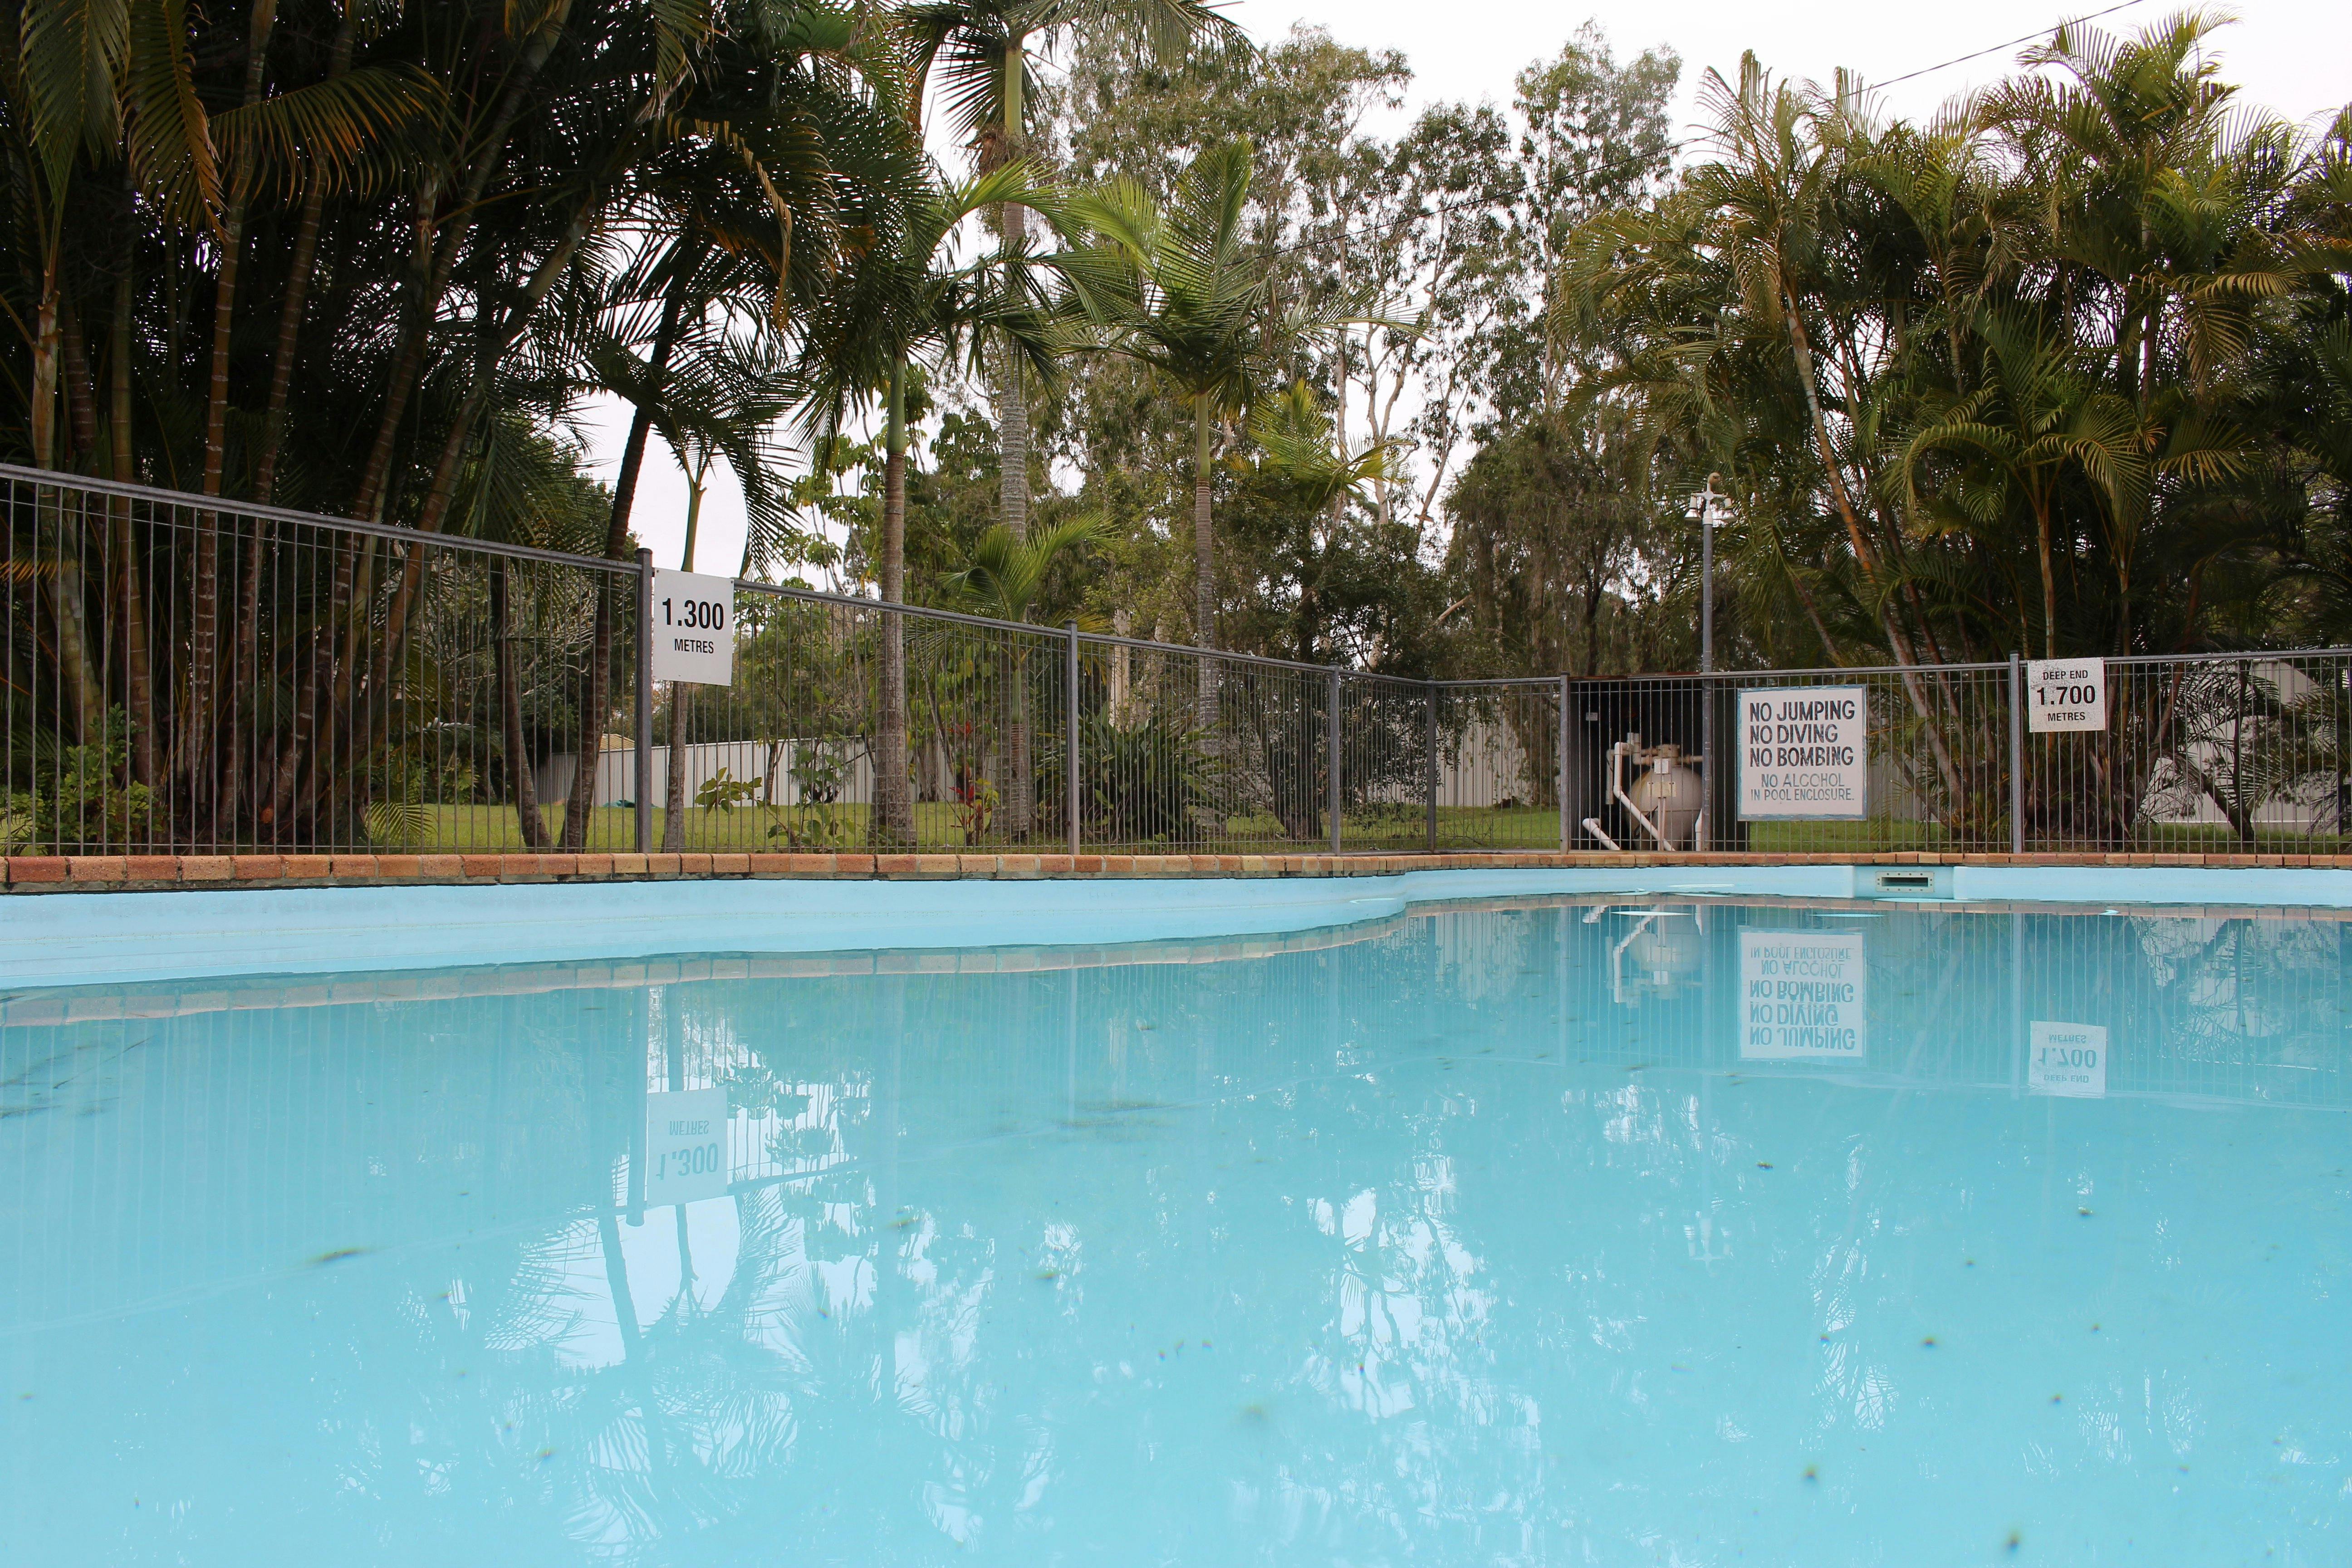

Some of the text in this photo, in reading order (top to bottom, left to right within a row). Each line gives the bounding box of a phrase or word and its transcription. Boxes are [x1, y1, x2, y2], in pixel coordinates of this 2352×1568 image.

[662, 598, 724, 630] 1.300
[675, 639, 714, 654] METRES
[2043, 670, 2088, 680] DEEP END
[2037, 685, 2095, 705] 1.700
[1749, 700, 1855, 722] NO JUMPING
[2048, 712, 2085, 721] METRES
[1750, 724, 1838, 744] NO DIVING
[1750, 746, 1853, 767] NO BOMBING
[1761, 773, 1844, 787] NO ALCOHOL
[1751, 788, 1854, 800] IN POOL ENCLOSURE.
